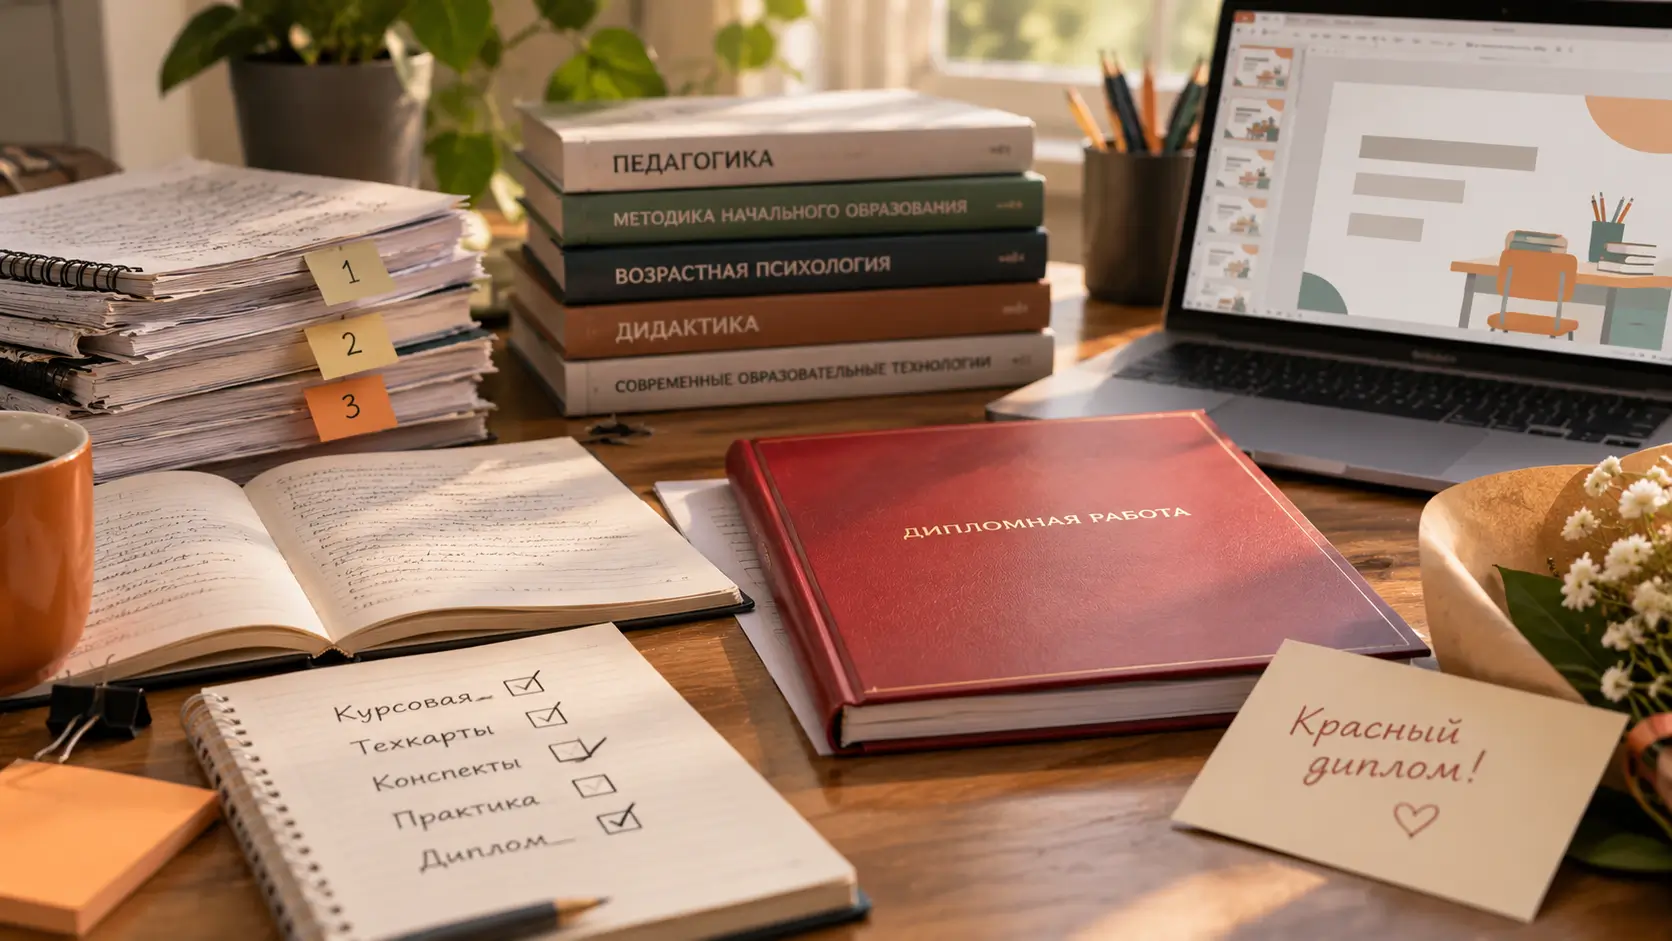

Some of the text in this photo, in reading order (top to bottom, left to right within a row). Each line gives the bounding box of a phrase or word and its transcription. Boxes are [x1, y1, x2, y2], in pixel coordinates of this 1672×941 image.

[613, 149, 774, 174] ПЕДАГОГИКА
[613, 199, 968, 228] МЕТОДИКА НАЧАЛЬНОГО ОБРАЗОВАНИЯ
[342, 259, 360, 284] 1
[614, 255, 891, 285] ВОЗРАСТНАЯ ПСИХОЛОГИЯ
[342, 332, 362, 356] 2
[615, 314, 760, 344] ДИДАКТИКА
[614, 373, 733, 394] СОВРЕМЕННЫЕ
[738, 361, 887, 385] ОБРАЗОВАТЕЛЬНЫЕ
[892, 355, 992, 376] ТЕХНОЛОГИИ
[342, 394, 361, 419] 3
[903, 506, 1192, 541] ДИПЛОМНАЯ РАБОТА
[349, 725, 495, 756] Техкарты
[1289, 704, 1461, 747] Красный
[372, 758, 522, 792] Конспекты
[1303, 750, 1486, 786] диплом!
[392, 795, 541, 832] Практика
